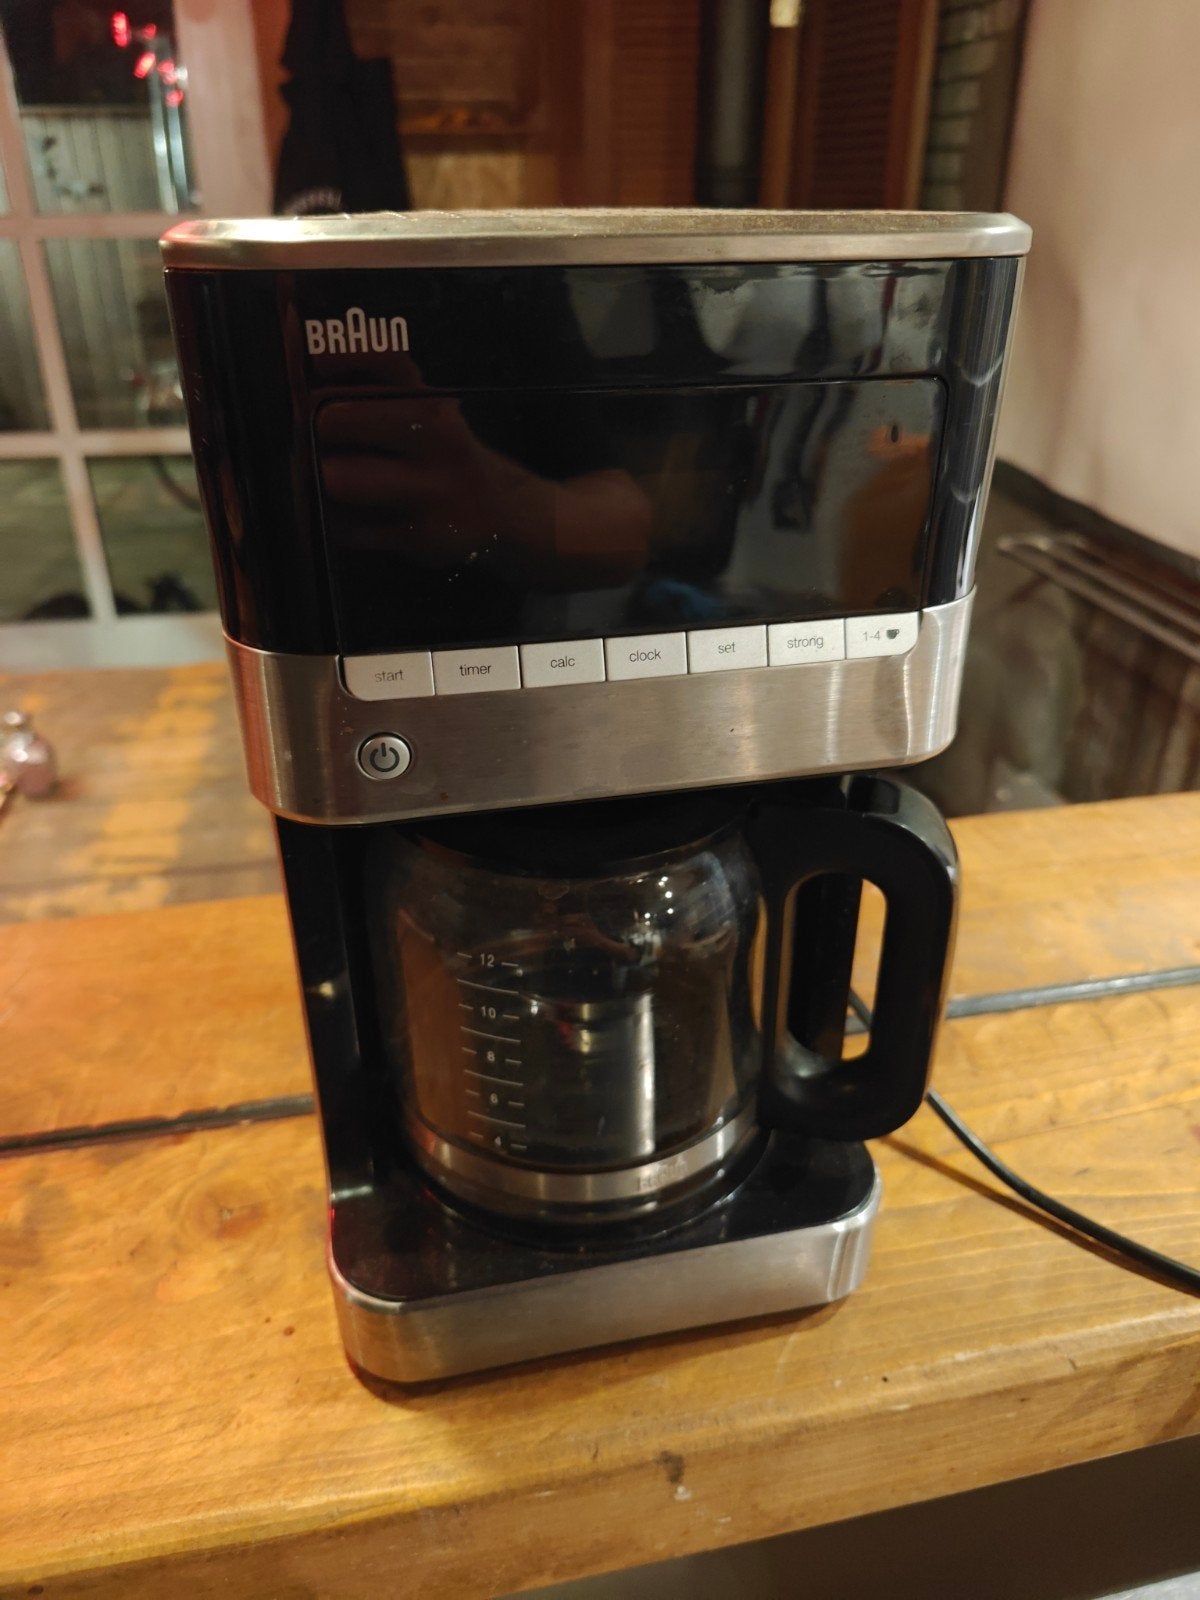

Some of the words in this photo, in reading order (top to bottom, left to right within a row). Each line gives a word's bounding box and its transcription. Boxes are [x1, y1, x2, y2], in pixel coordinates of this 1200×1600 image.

[305, 307, 409, 354] BRAUN
[787, 634, 825, 649] strong
[863, 630, 881, 641] 1-4
[717, 641, 737, 654] set
[550, 655, 576, 669] calc
[629, 648, 662, 663] clock
[375, 669, 404, 683] start
[459, 663, 492, 677] timer
[480, 953, 495, 967] 12
[481, 1006, 497, 1019] 10
[487, 1051, 496, 1062] 8
